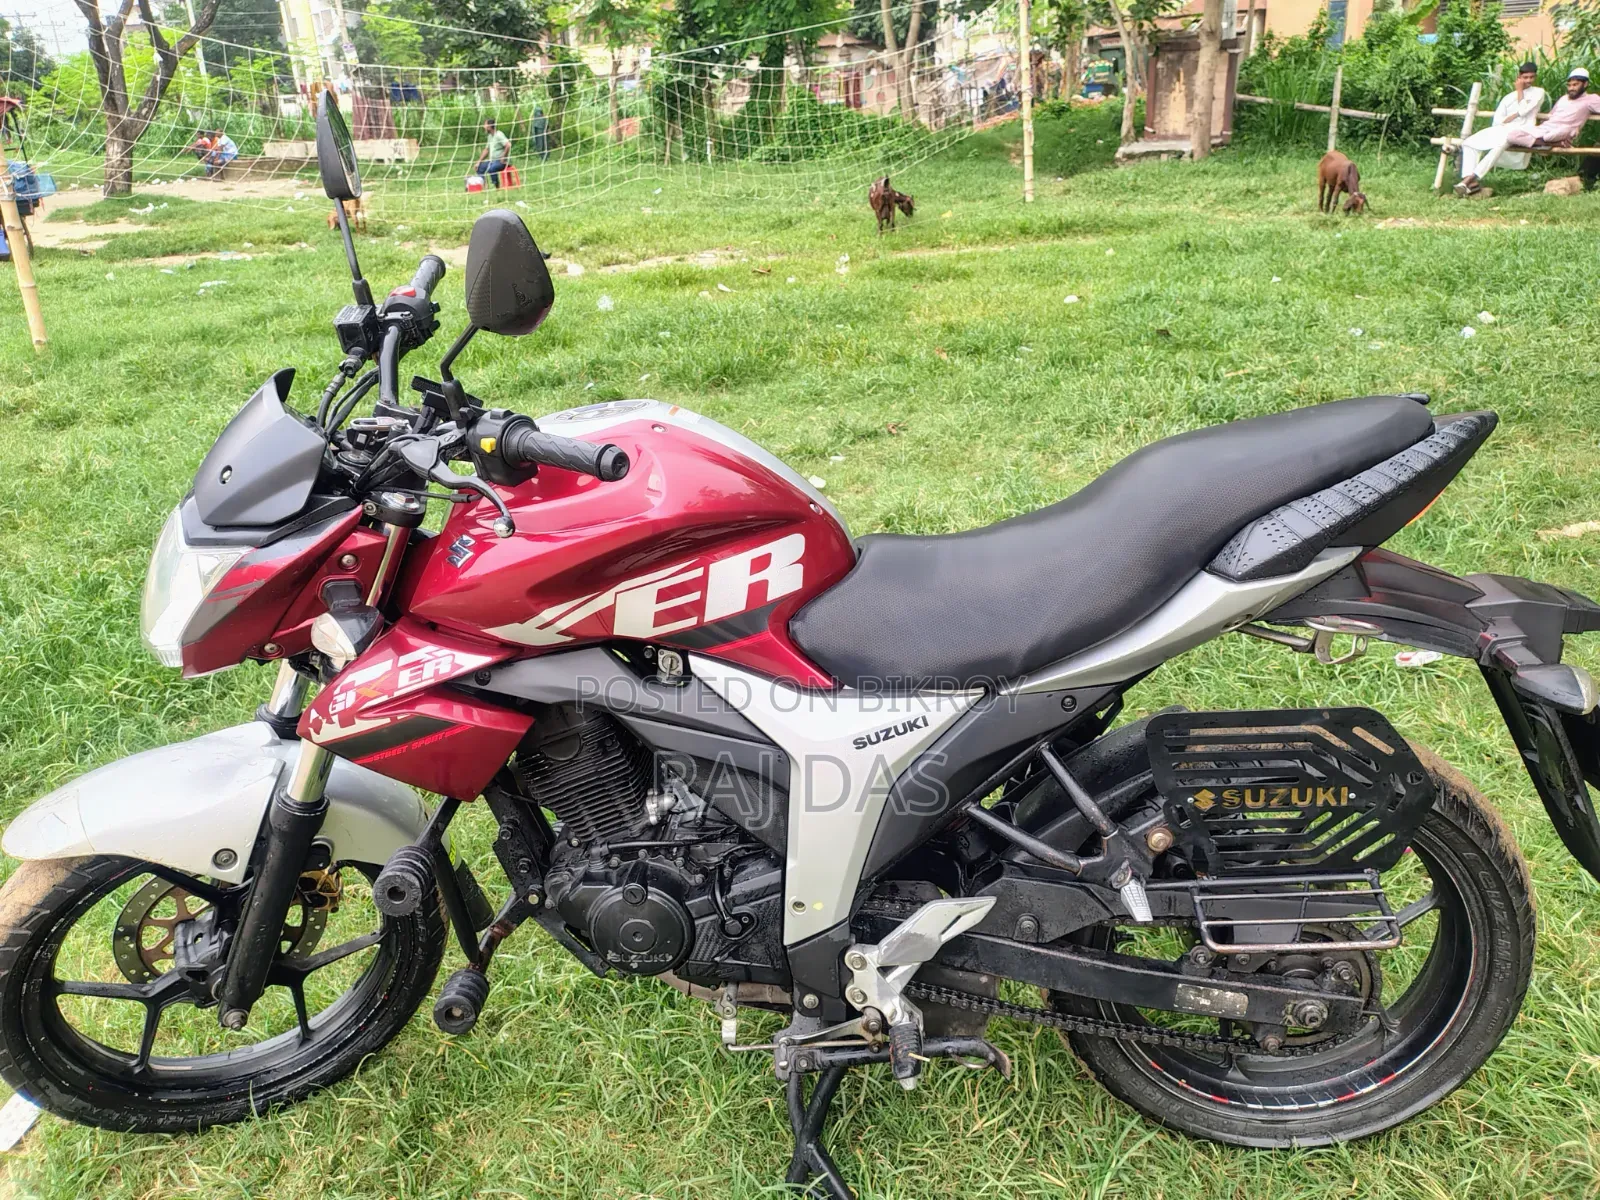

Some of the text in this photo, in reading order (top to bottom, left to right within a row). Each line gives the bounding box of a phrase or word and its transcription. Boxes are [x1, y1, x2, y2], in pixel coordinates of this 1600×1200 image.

[852, 714, 929, 750] SUZUKI
[373, 731, 446, 761] STREET SPORT
[1221, 786, 1349, 809] SUZUKI
[607, 952, 673, 963] SUZUKI
